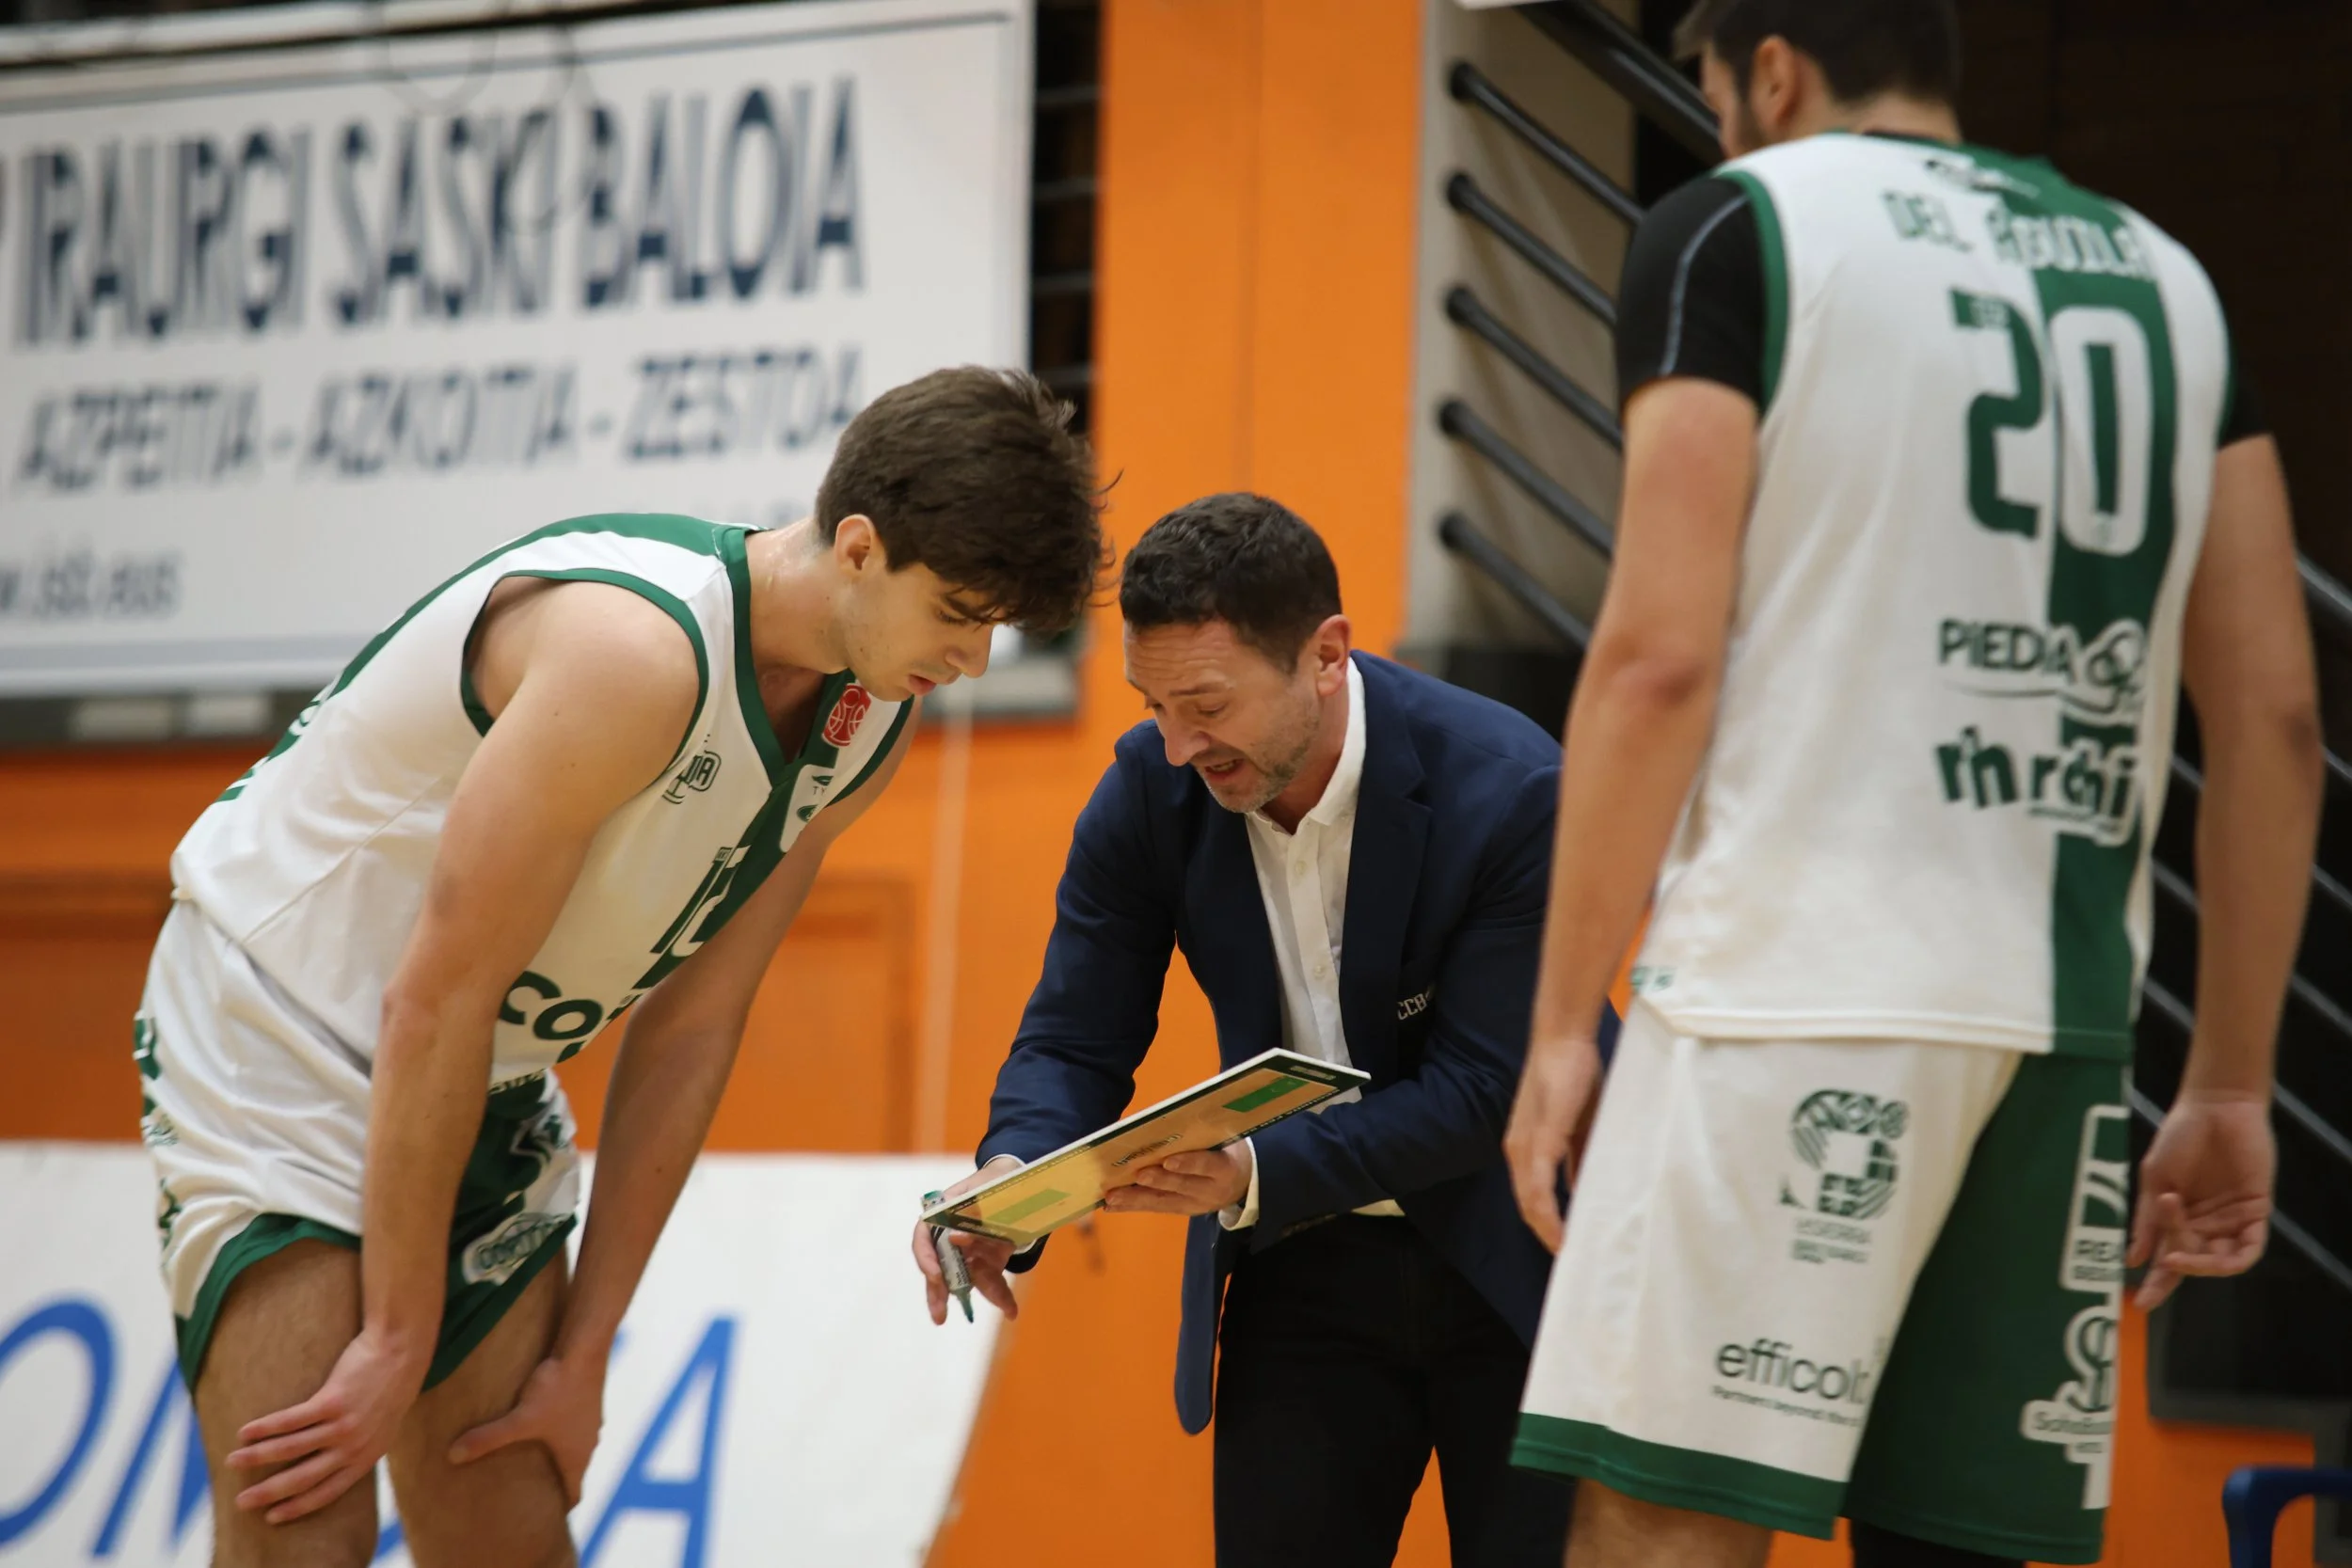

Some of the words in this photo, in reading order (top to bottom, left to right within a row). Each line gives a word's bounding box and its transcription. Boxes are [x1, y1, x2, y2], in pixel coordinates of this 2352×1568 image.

[15, 130, 312, 348] IRAURGI
[327, 107, 557, 325] SASKI
[576, 77, 864, 314] BALOIA
[1949, 286, 2156, 557] 20
